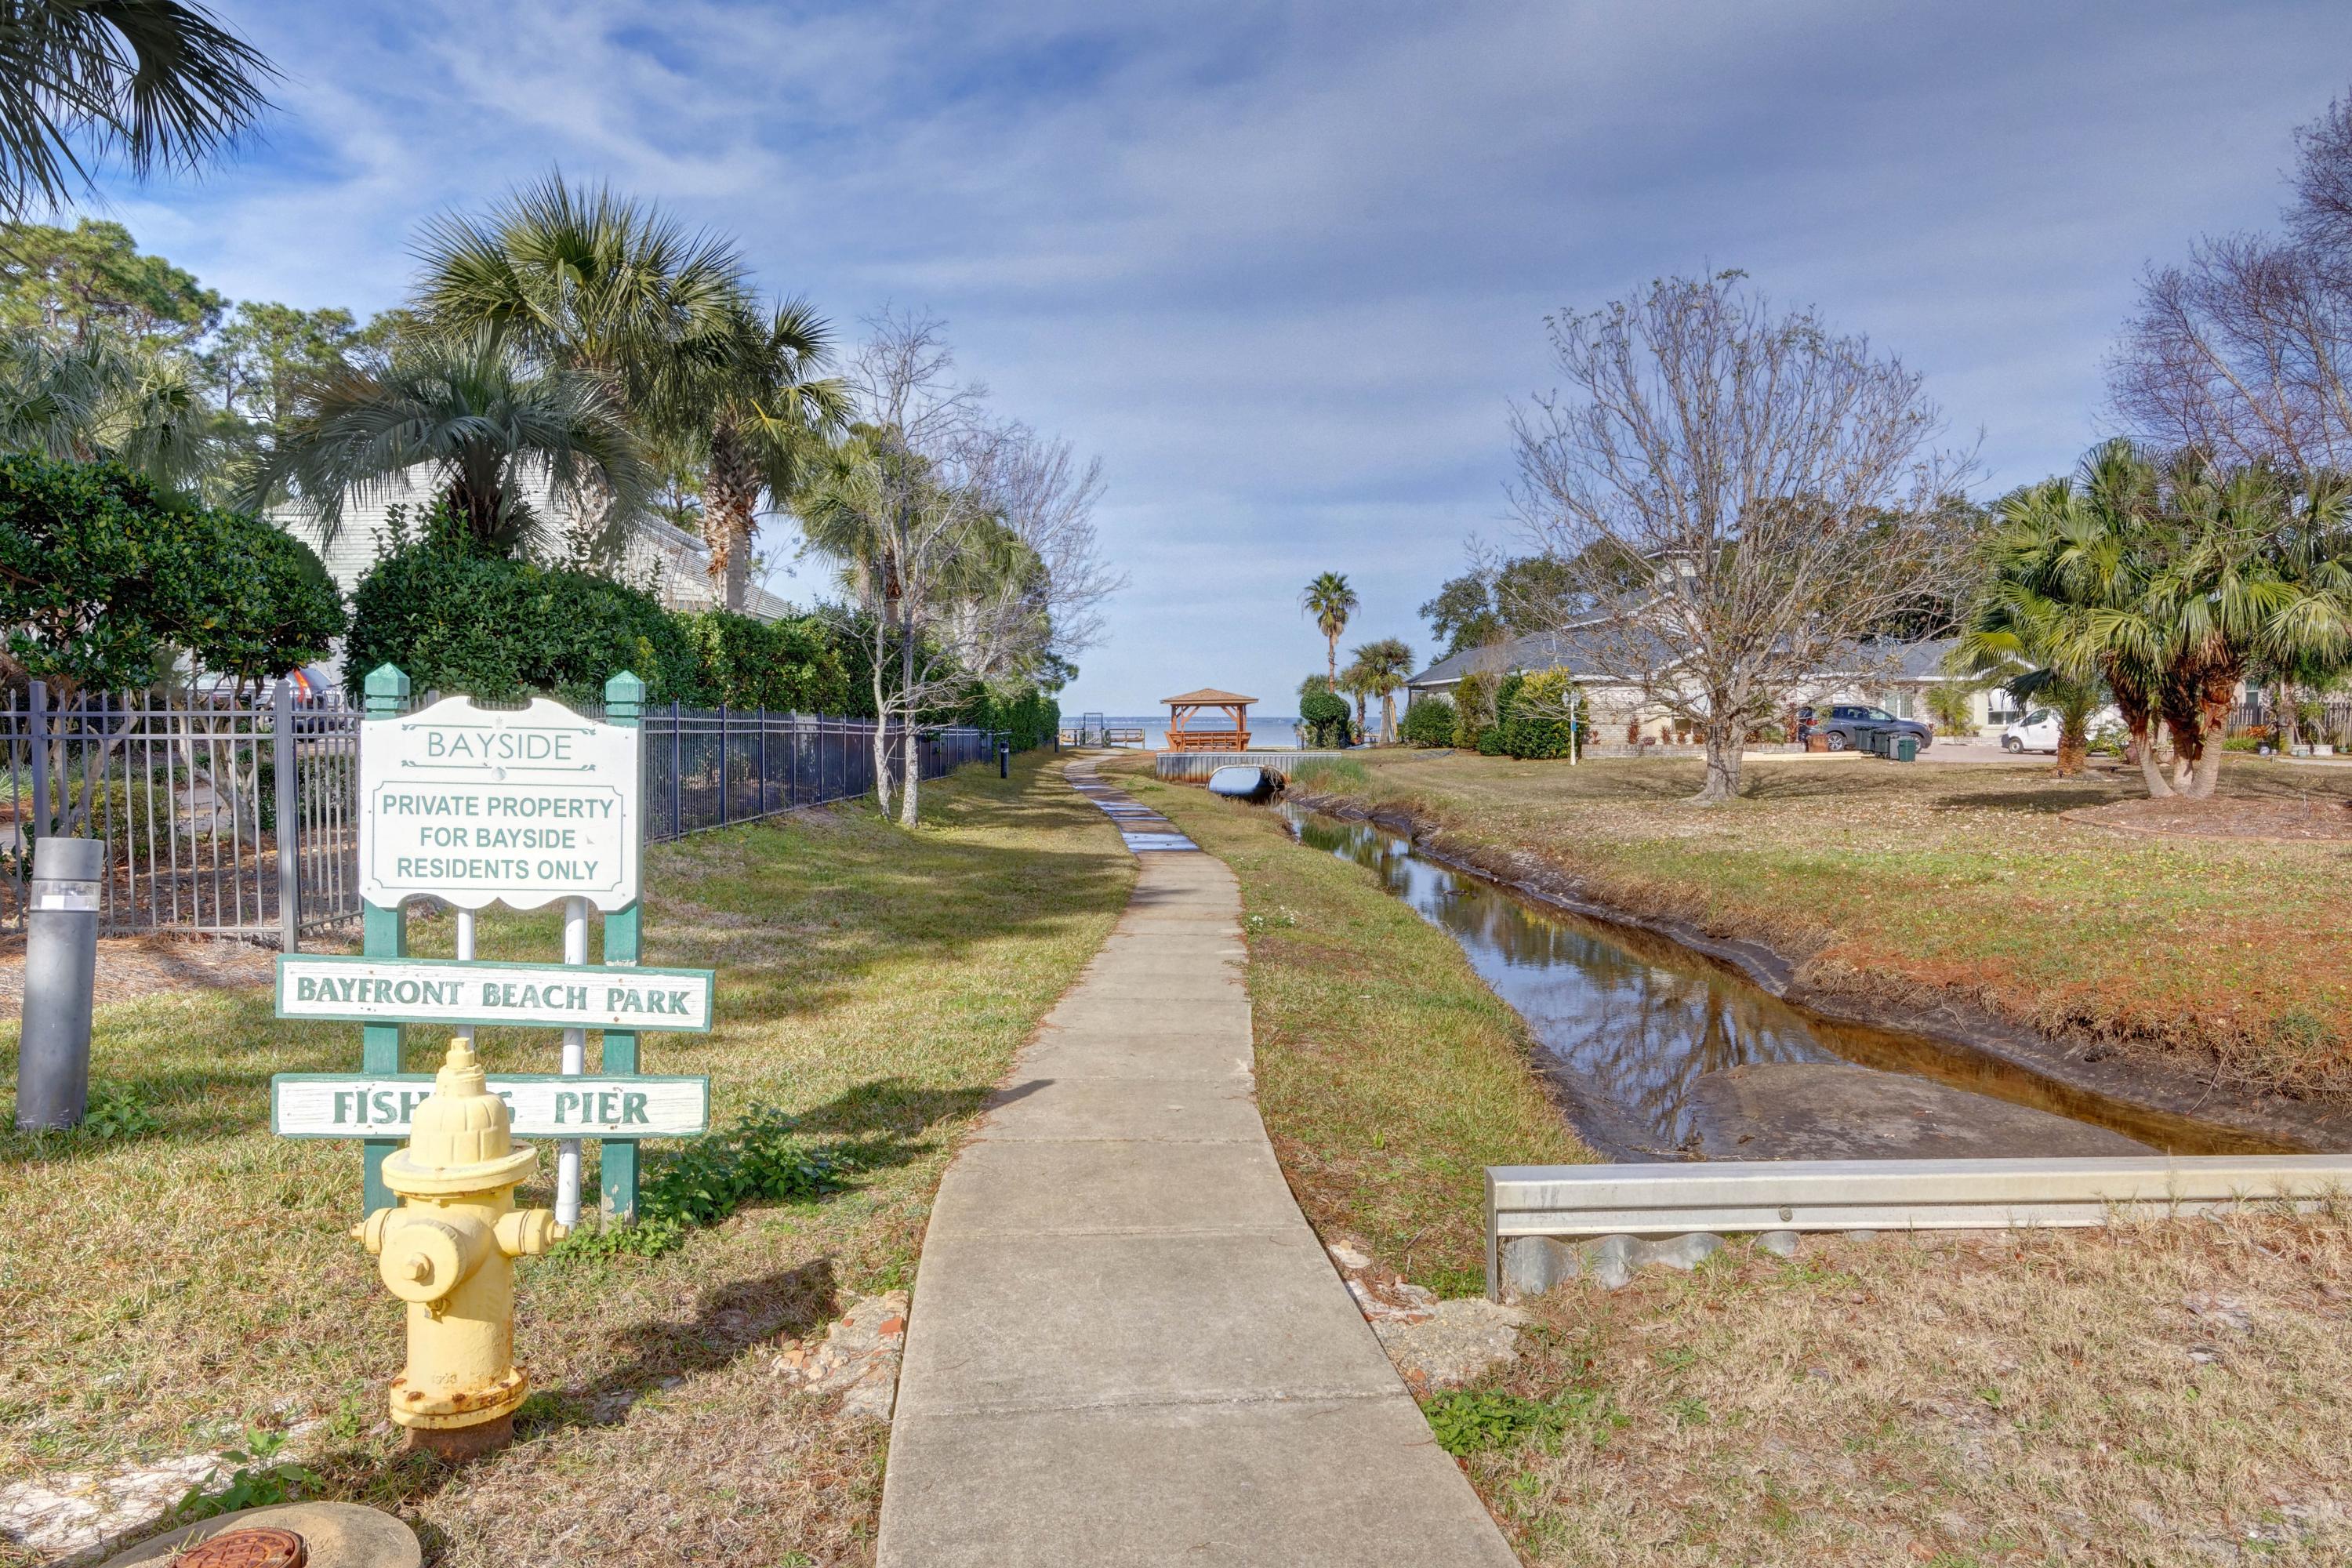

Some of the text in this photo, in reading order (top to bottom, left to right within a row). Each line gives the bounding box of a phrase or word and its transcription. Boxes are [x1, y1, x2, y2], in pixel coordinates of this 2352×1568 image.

[428, 731, 572, 760] BAYSIDE
[383, 795, 614, 818] PRIVATE PROPERTY
[420, 827, 575, 849] FOR BAYSIDE
[397, 858, 598, 880] RESIDENTS ONLY
[296, 977, 690, 1015] BAYFRONT BEACH PARK
[333, 1091, 649, 1124] FISH PIER
